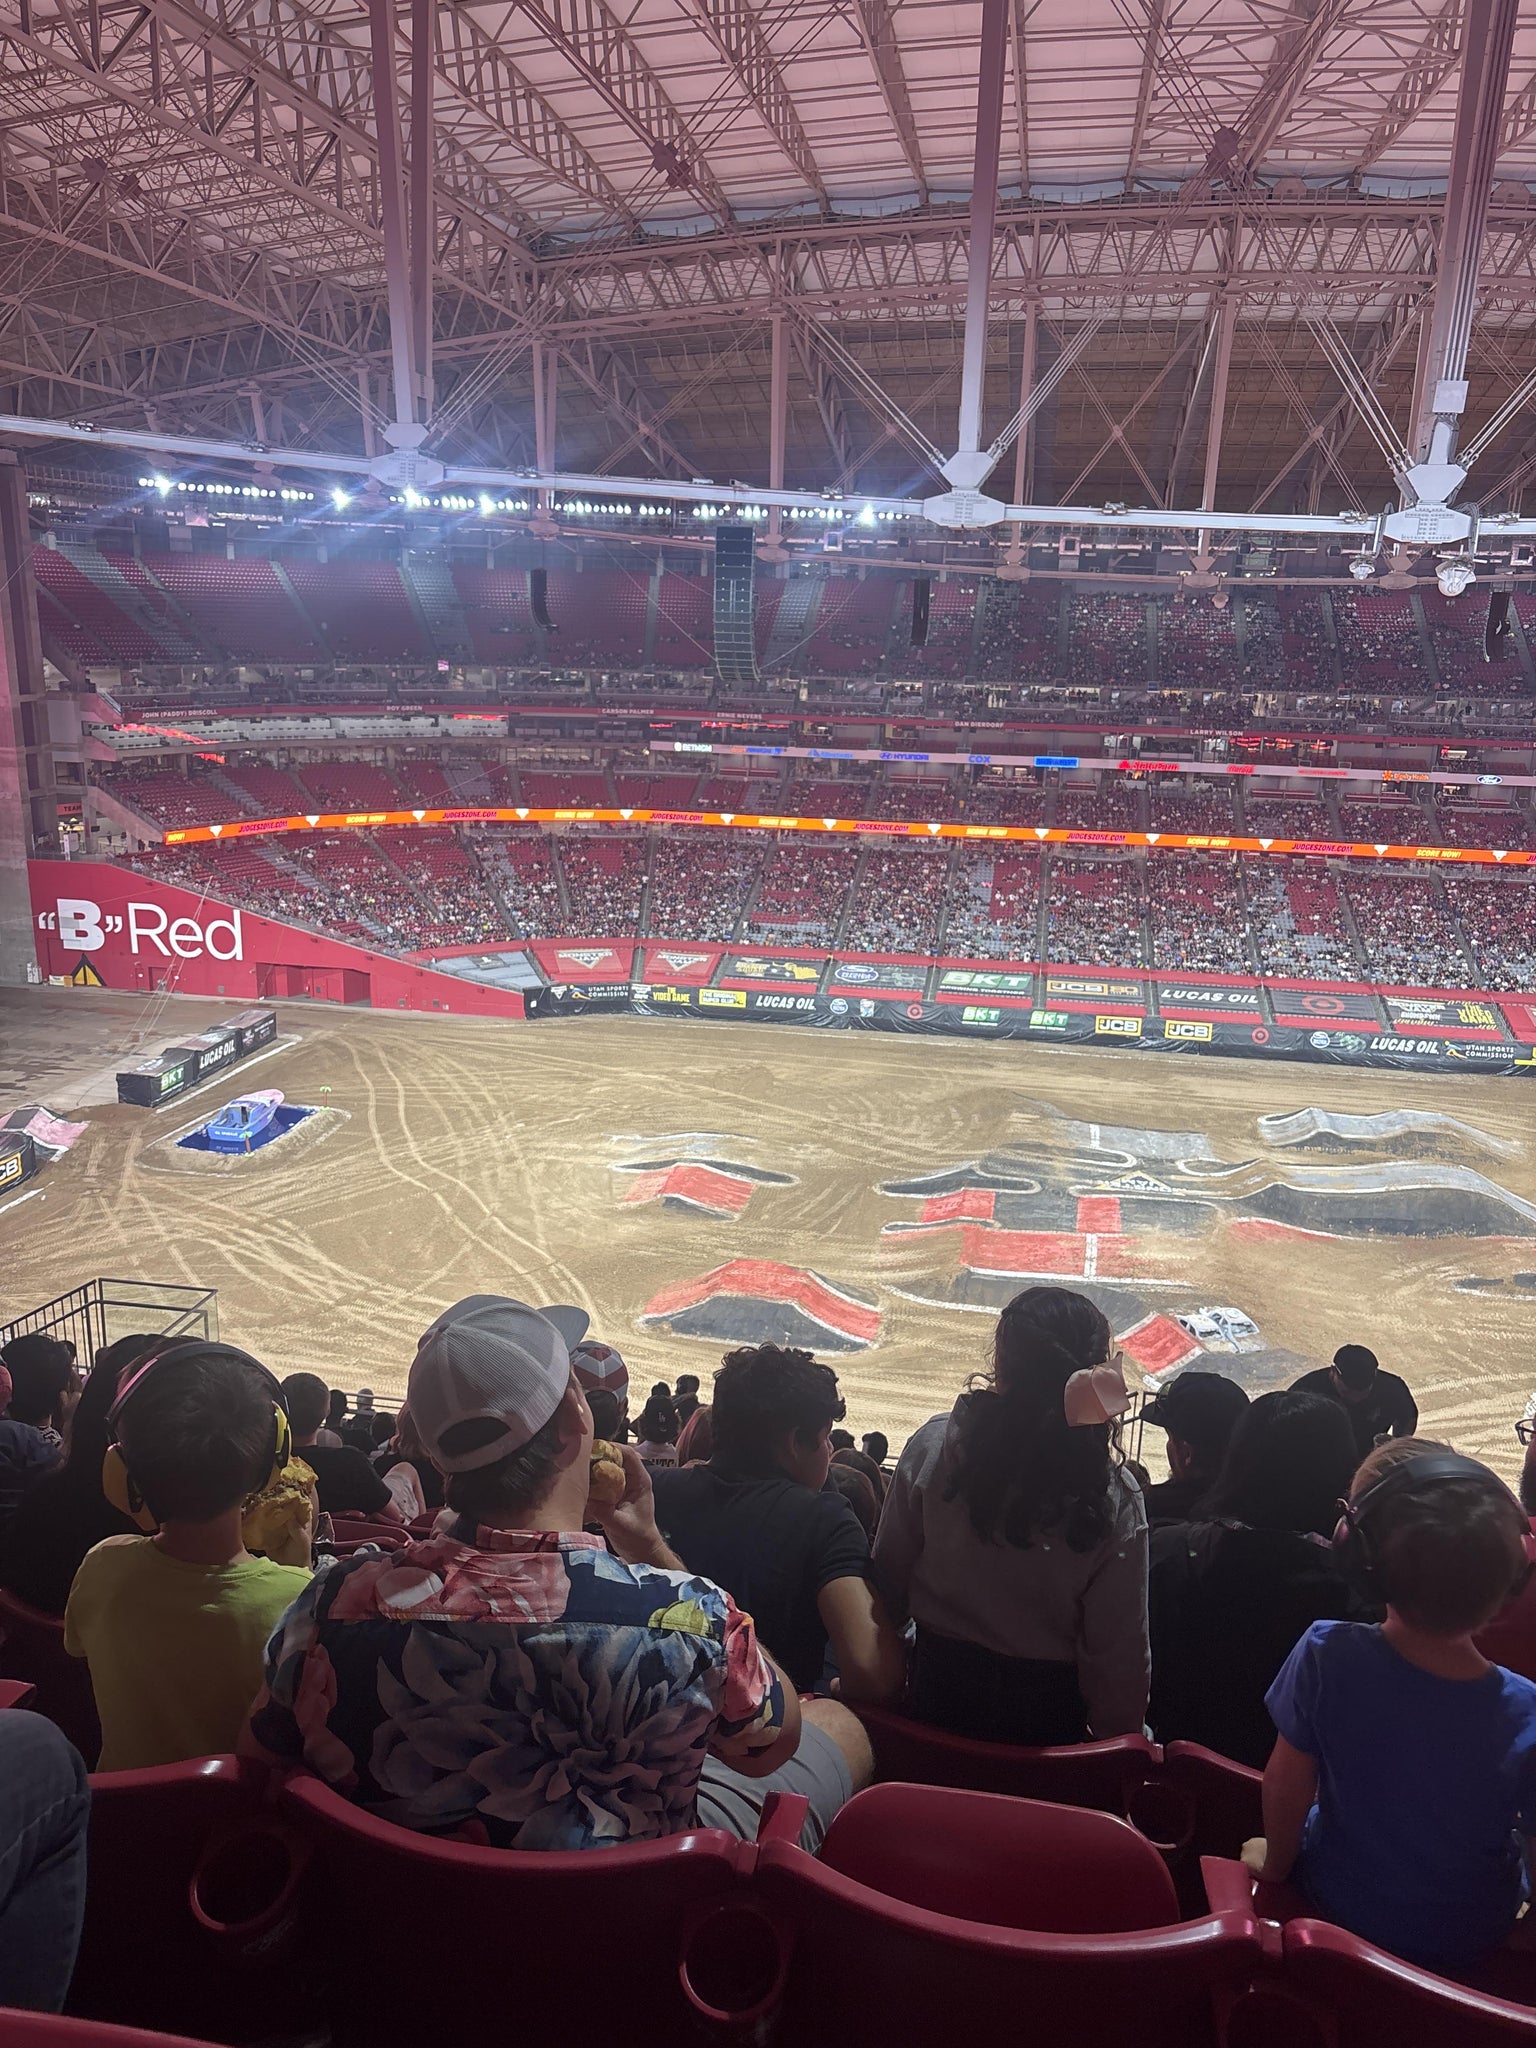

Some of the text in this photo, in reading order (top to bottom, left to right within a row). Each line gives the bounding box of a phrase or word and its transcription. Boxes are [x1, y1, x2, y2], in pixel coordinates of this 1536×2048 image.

[443, 811, 497, 819] JUDGESZONE.COM
[651, 812, 703, 821] JUDGESZONE.COM
[1067, 834, 1125, 842] JUDGESZONE.COM
[1292, 843, 1353, 853] JUDGESZONE.COM
[1416, 849, 1461, 858] SCORE NOW!
[128, 902, 243, 961] Red
[943, 972, 1029, 987] BKT
[1051, 982, 1102, 992] JCB
[756, 995, 795, 1009] LUCAS
[1161, 989, 1259, 1003] LUCAS OIL
[963, 1007, 1000, 1021] BKT
[1031, 1012, 1067, 1025] BKT
[1100, 1019, 1138, 1032] JCB
[1169, 1024, 1209, 1037] JCB
[1370, 1038, 1416, 1052] LUCAS
[200, 1039, 235, 1069] LUCAS OIL
[161, 1067, 184, 1088] BKT
